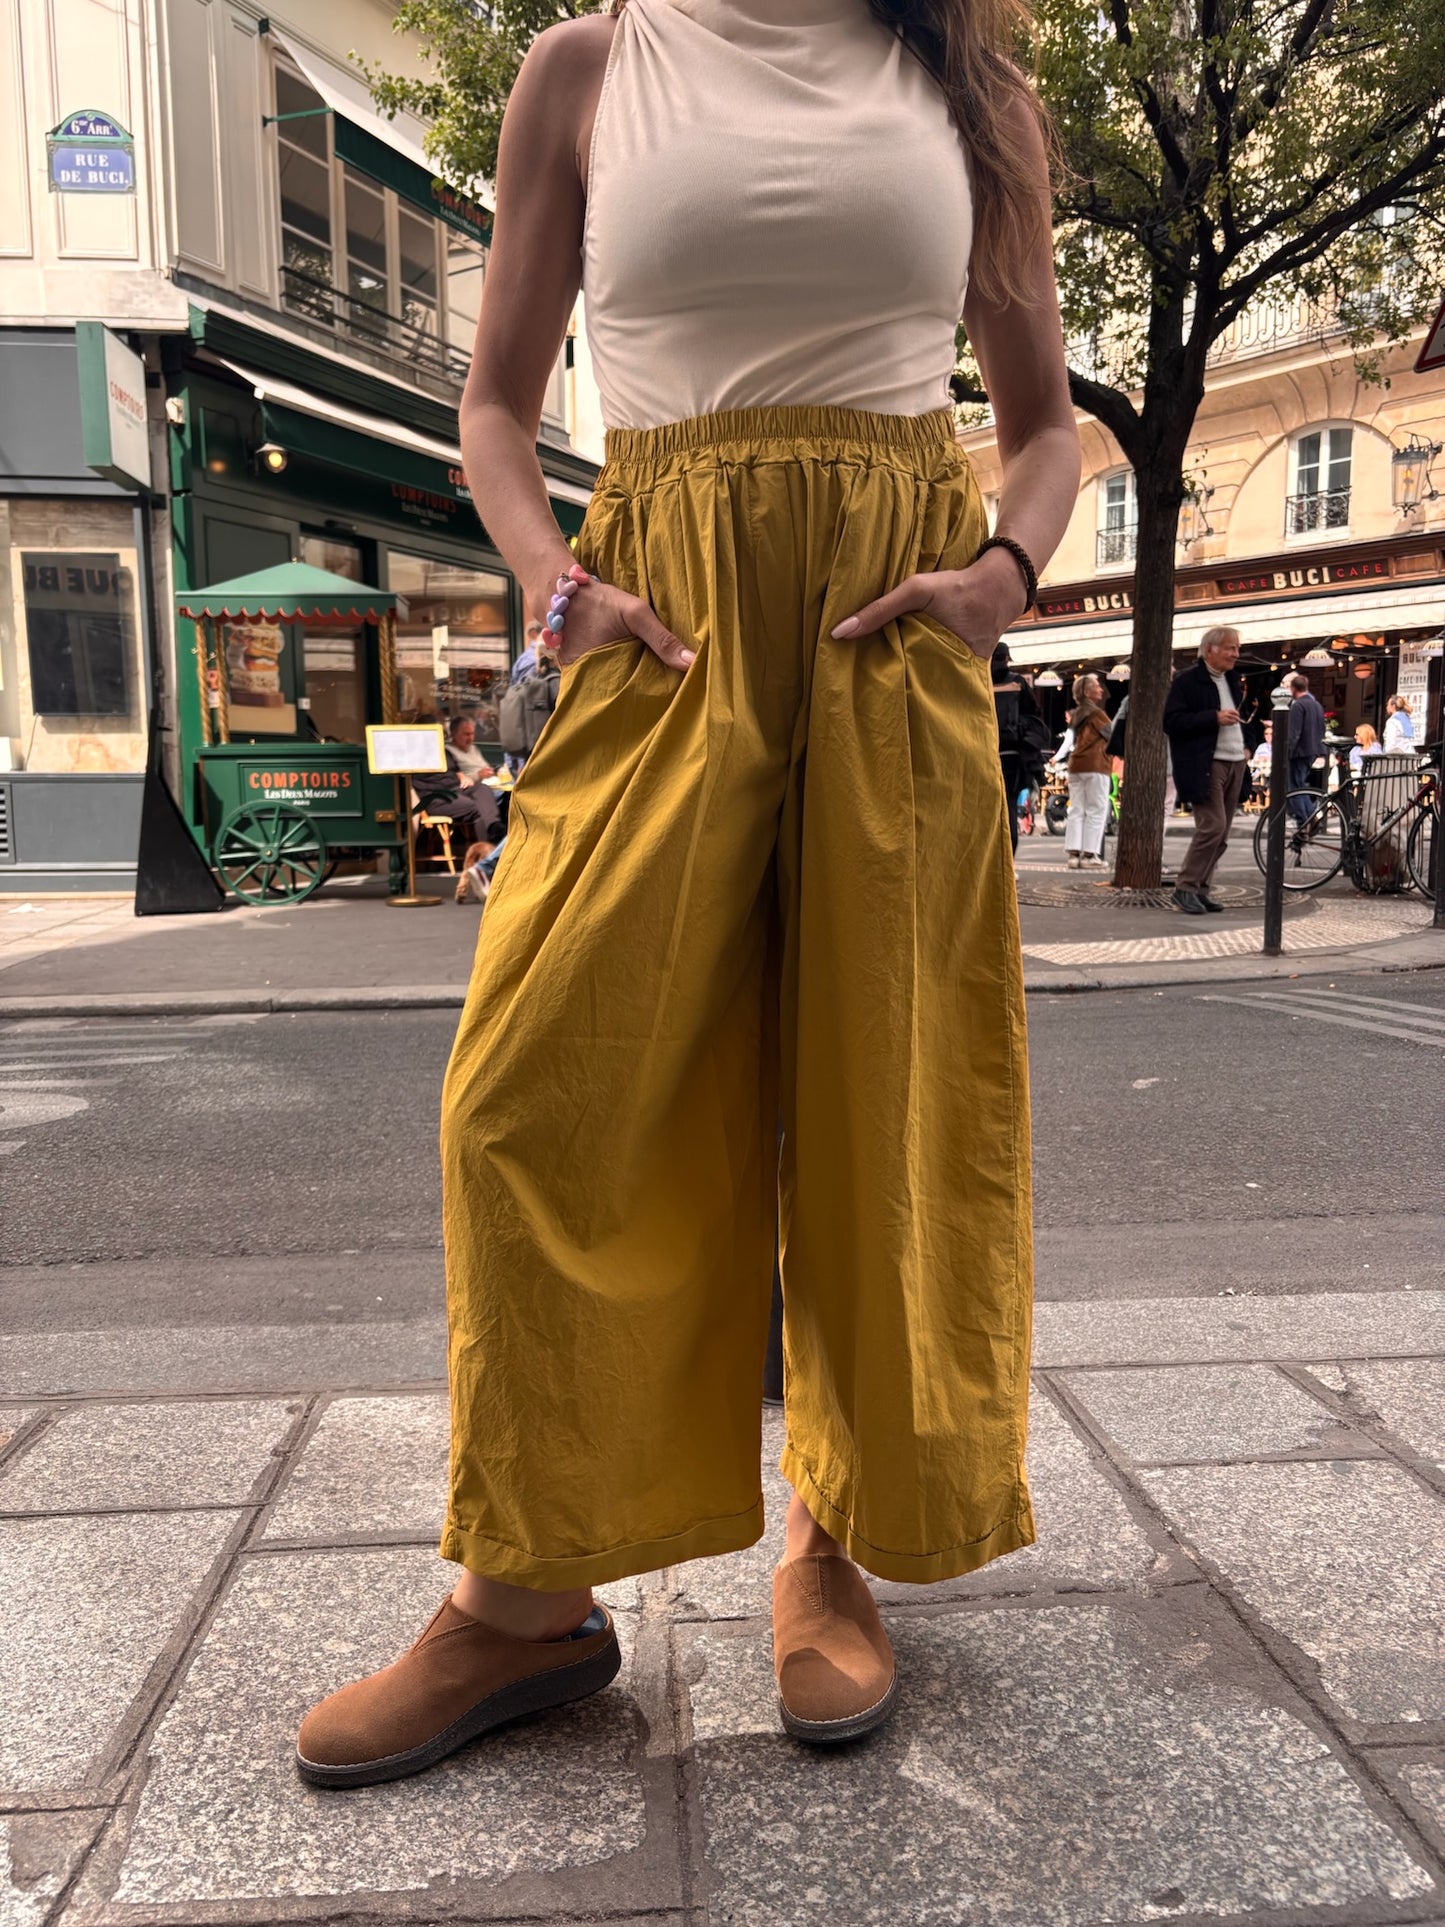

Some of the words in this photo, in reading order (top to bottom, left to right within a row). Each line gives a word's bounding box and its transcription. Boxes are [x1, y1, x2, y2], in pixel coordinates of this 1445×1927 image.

[75, 154, 109, 167] RUE
[60, 170, 82, 183] DE
[1226, 578, 1268, 592] CAFE
[1273, 566, 1331, 590] BUCI
[1336, 563, 1383, 578] CAFE
[1046, 601, 1080, 614] CAFE
[1083, 592, 1130, 613] BUCI
[249, 772, 351, 789] COMPTOIRS
